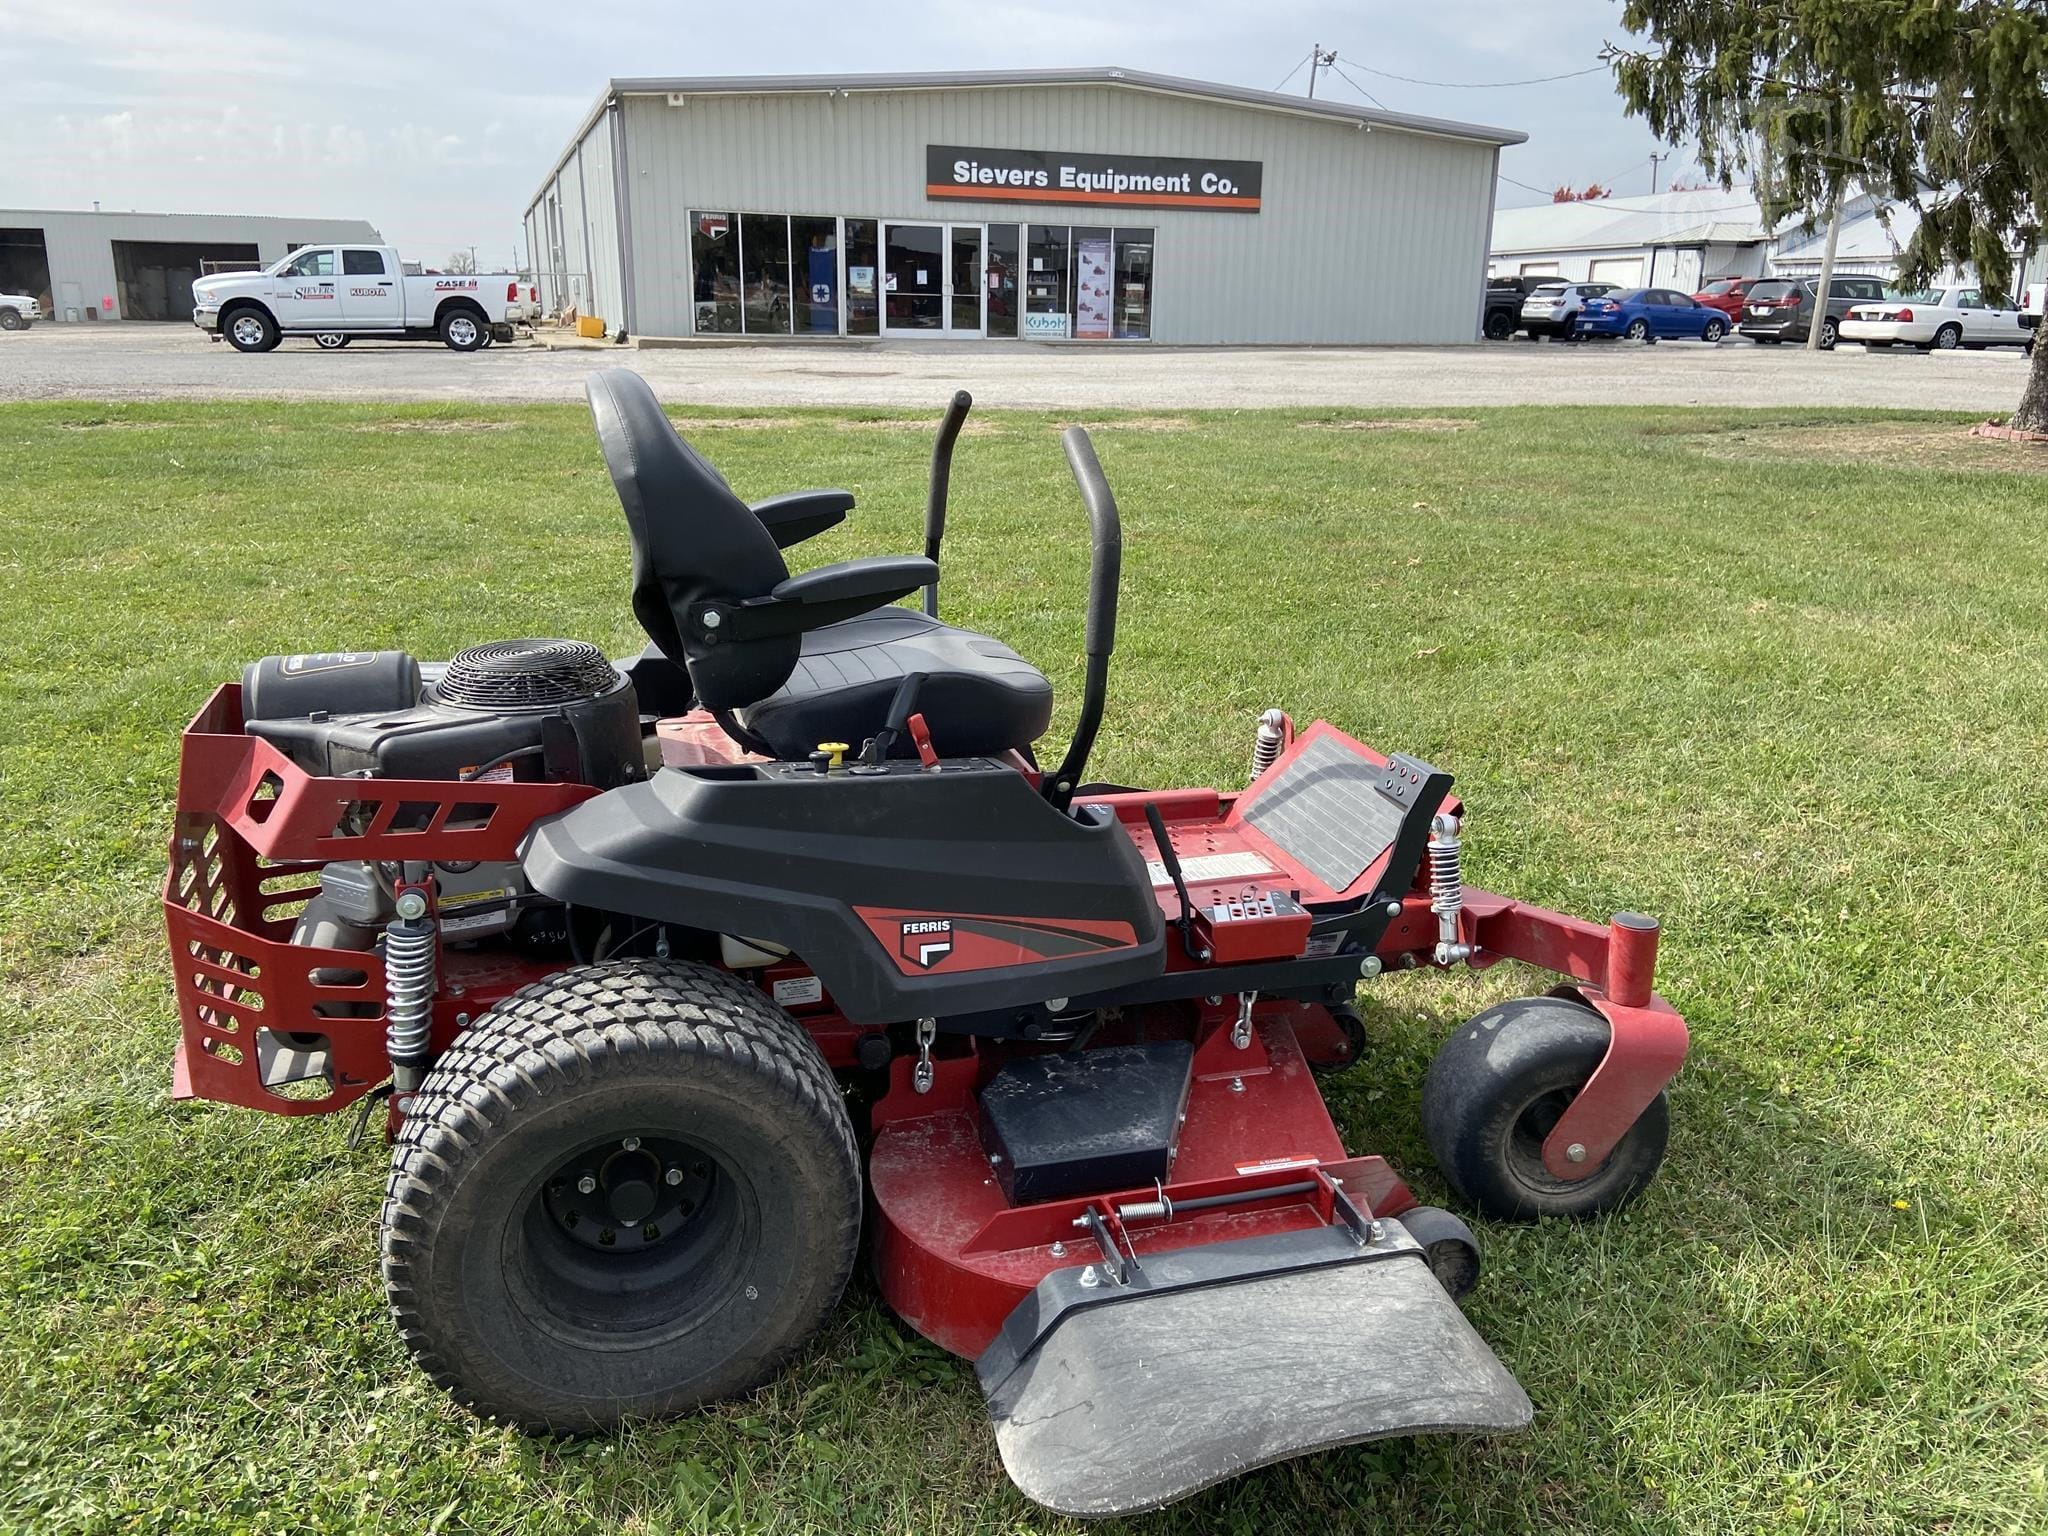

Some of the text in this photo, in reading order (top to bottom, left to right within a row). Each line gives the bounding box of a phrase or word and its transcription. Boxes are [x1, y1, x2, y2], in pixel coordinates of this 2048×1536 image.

[953, 161, 1239, 195] Sievers Equipment Co.
[436, 280, 466, 288] CASE
[294, 286, 335, 300] SIEVERS
[350, 287, 387, 297] KUBOTA
[903, 920, 951, 934] FERRIS
